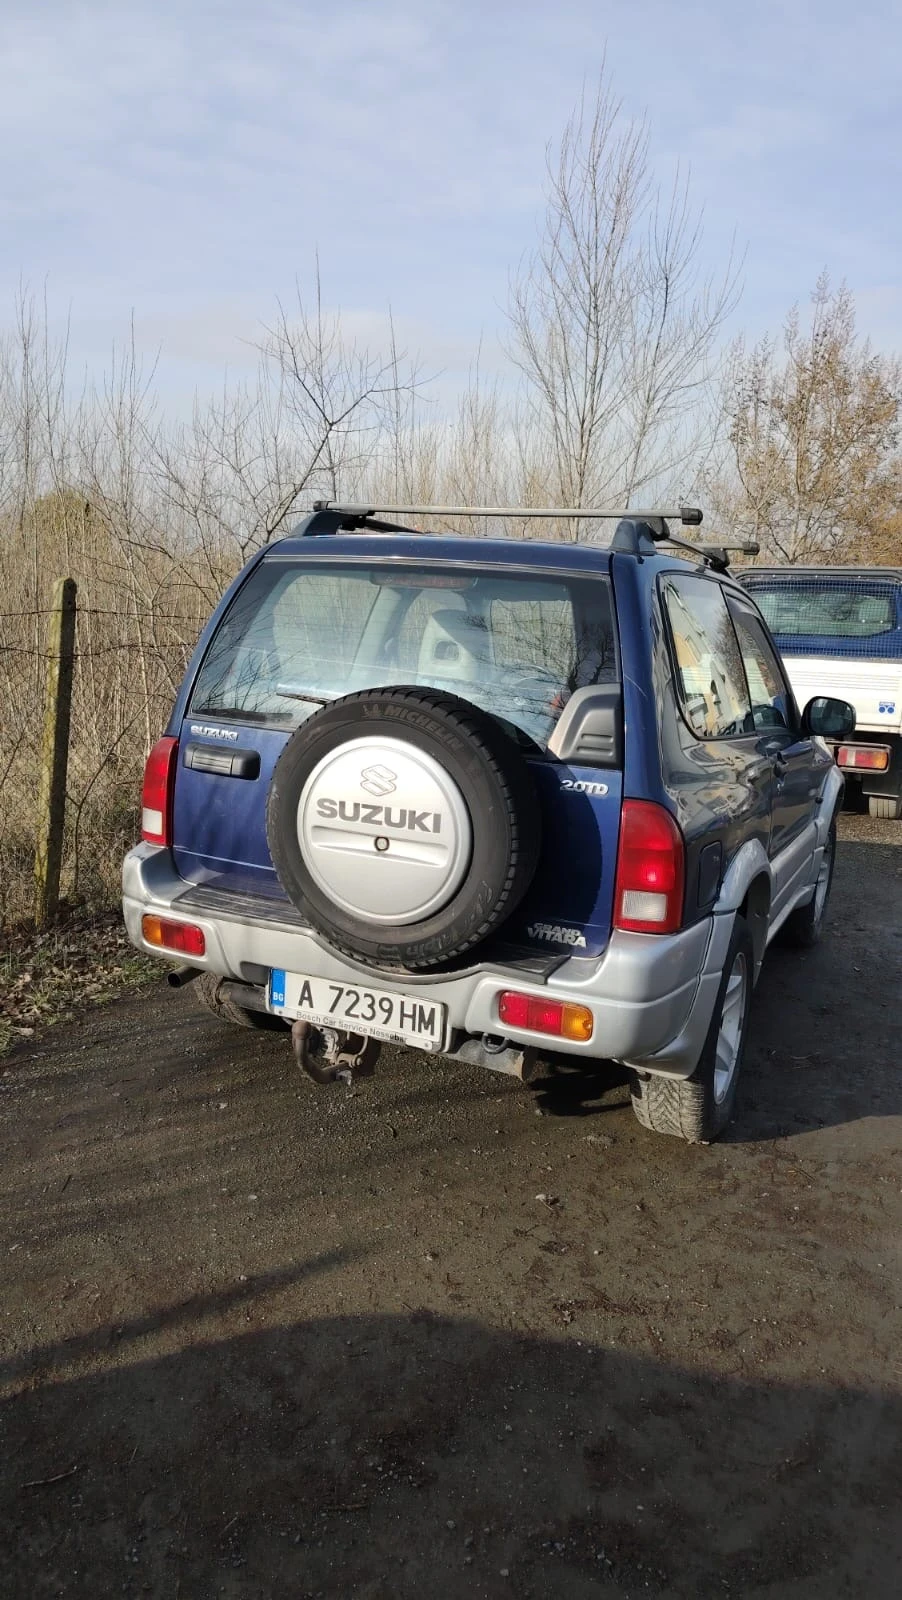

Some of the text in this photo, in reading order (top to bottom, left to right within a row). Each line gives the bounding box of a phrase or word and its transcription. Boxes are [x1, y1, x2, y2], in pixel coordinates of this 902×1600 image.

[191, 725, 238, 740] SUZUKI
[384, 704, 465, 752] MICHELIN
[316, 798, 442, 834] SUZUKI
[527, 927, 587, 948] VITARA
[534, 922, 582, 937] GRAND
[272, 991, 284, 1002] BG
[298, 980, 436, 1036] A 7239 HM
[296, 1011, 407, 1043] Bosch Car Service Nesseb
